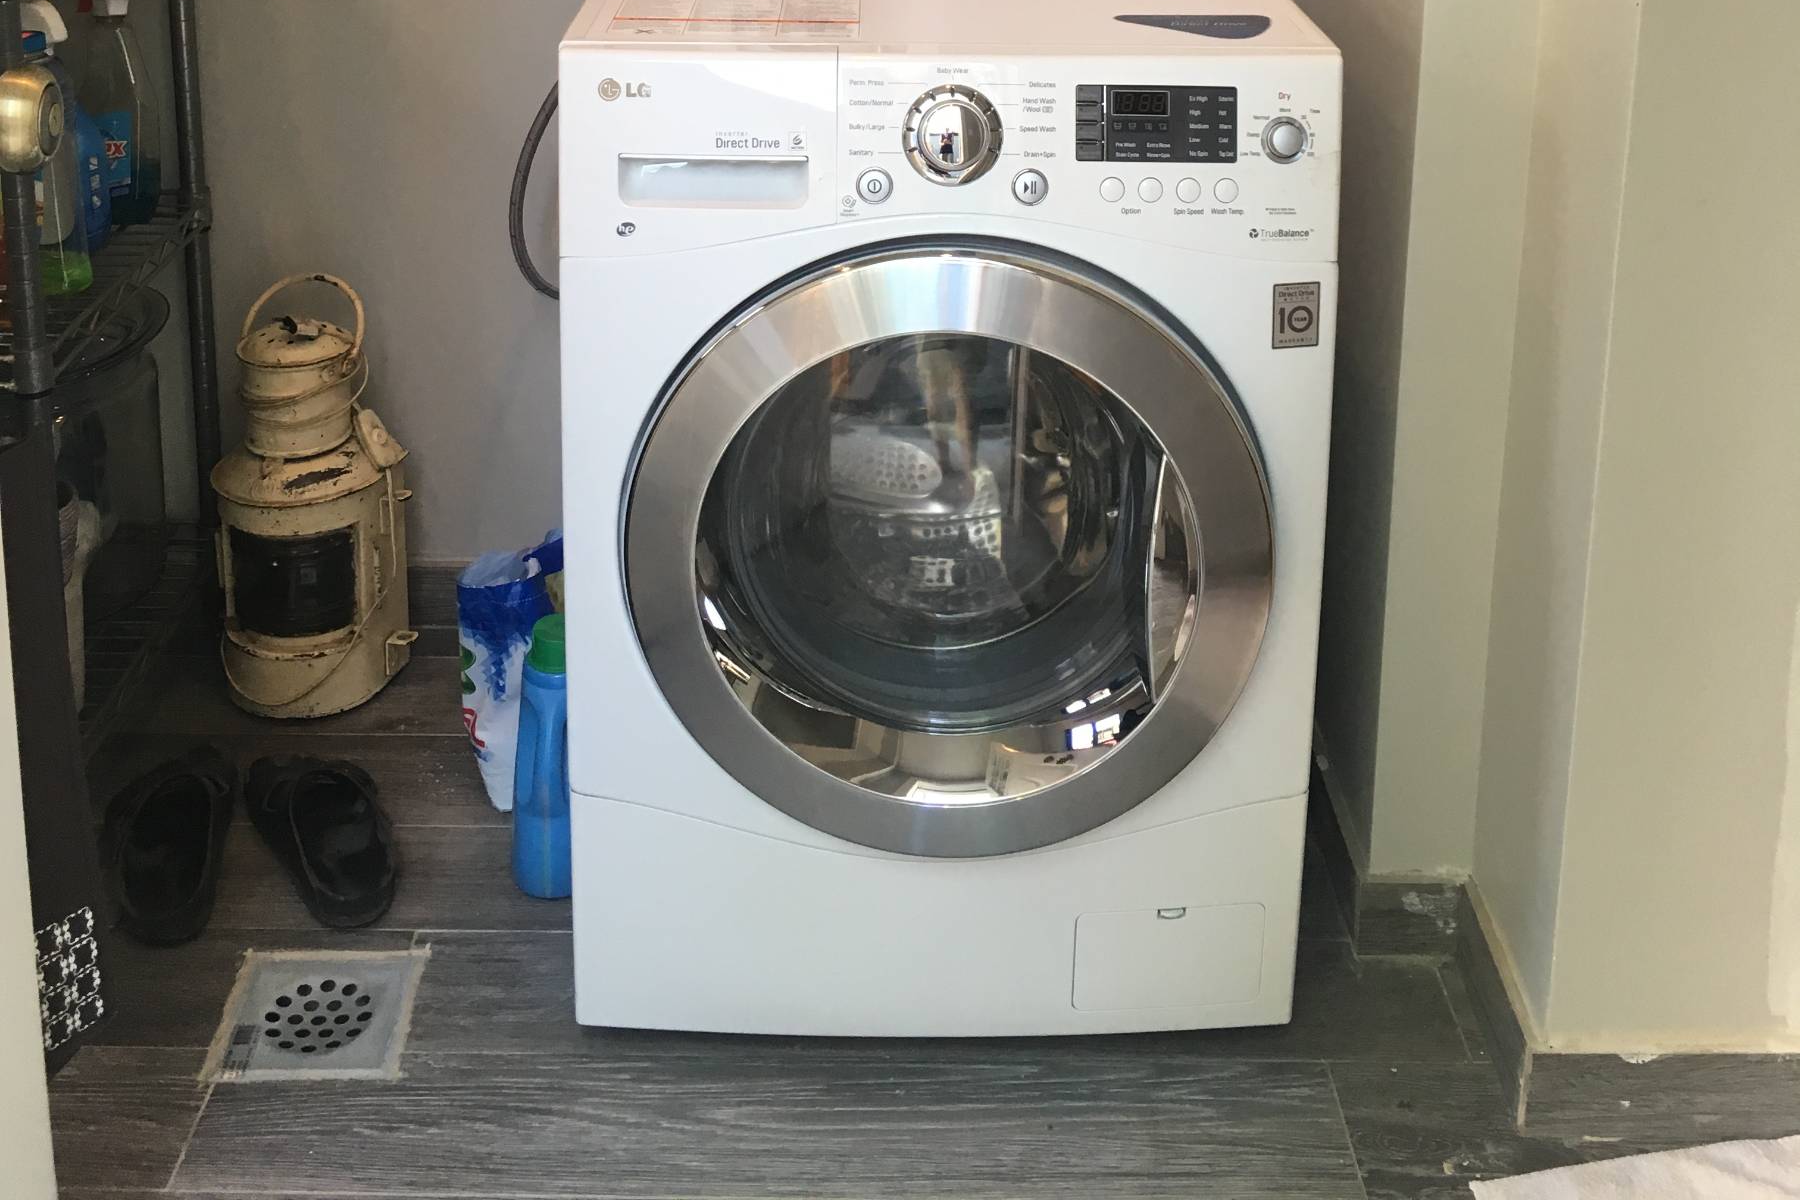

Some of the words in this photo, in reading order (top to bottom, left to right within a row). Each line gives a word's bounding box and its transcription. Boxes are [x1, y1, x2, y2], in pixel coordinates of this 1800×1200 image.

[936, 67, 951, 75] Baby
[1277, 91, 1291, 101] Dry
[1022, 97, 1038, 105] Hand
[1039, 97, 1056, 105] Wash
[1019, 125, 1037, 133] Speed
[1039, 125, 1056, 133] Wash
[715, 137, 749, 149] Direct
[751, 137, 781, 149] Drive
[848, 149, 874, 157] Sanitary
[1120, 207, 1142, 216] Option
[1173, 207, 1187, 216] Spin
[1187, 207, 1205, 216] Speed
[1210, 207, 1228, 215] Wash
[1278, 305, 1313, 334] 10
